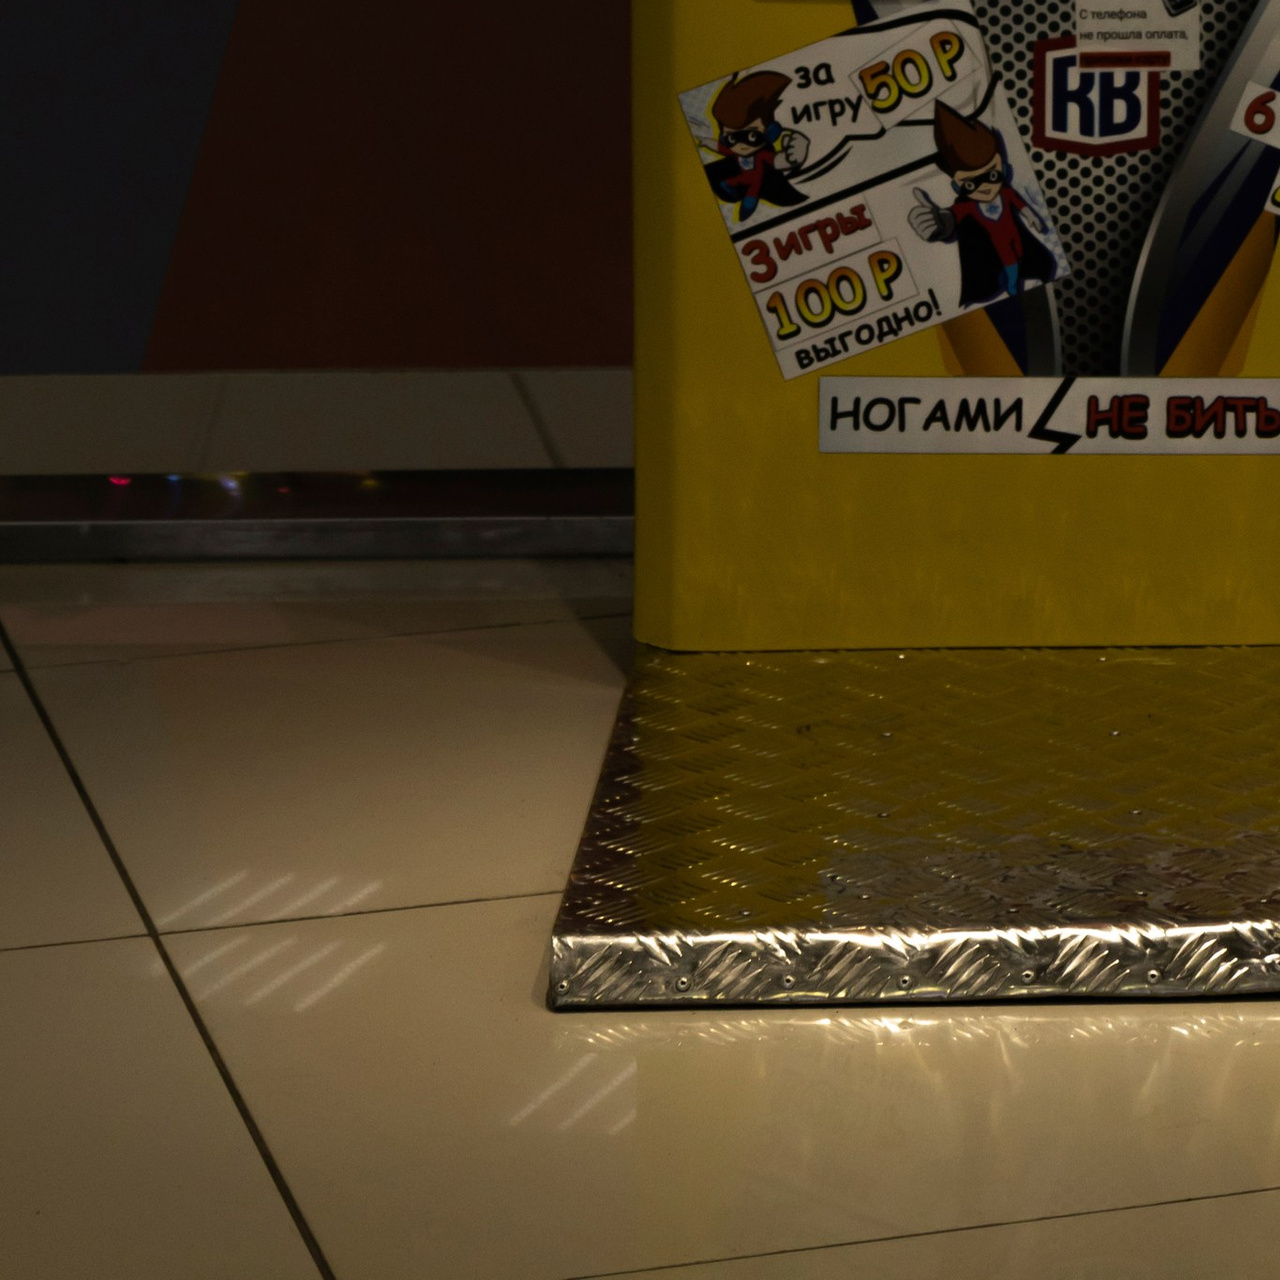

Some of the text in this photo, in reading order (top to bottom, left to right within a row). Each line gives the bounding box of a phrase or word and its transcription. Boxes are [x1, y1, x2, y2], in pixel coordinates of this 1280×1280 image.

[1079, 8, 1147, 21] С телефона
[1079, 30, 1188, 42] не прошла оплата,
[792, 94, 863, 127] игру
[859, 49, 933, 113] 50
[1244, 91, 1276, 134] 6
[742, 204, 872, 284] 3 игры
[766, 266, 868, 341] 100
[829, 396, 1024, 433] НОГАМИ
[1087, 394, 1150, 439] НЕ
